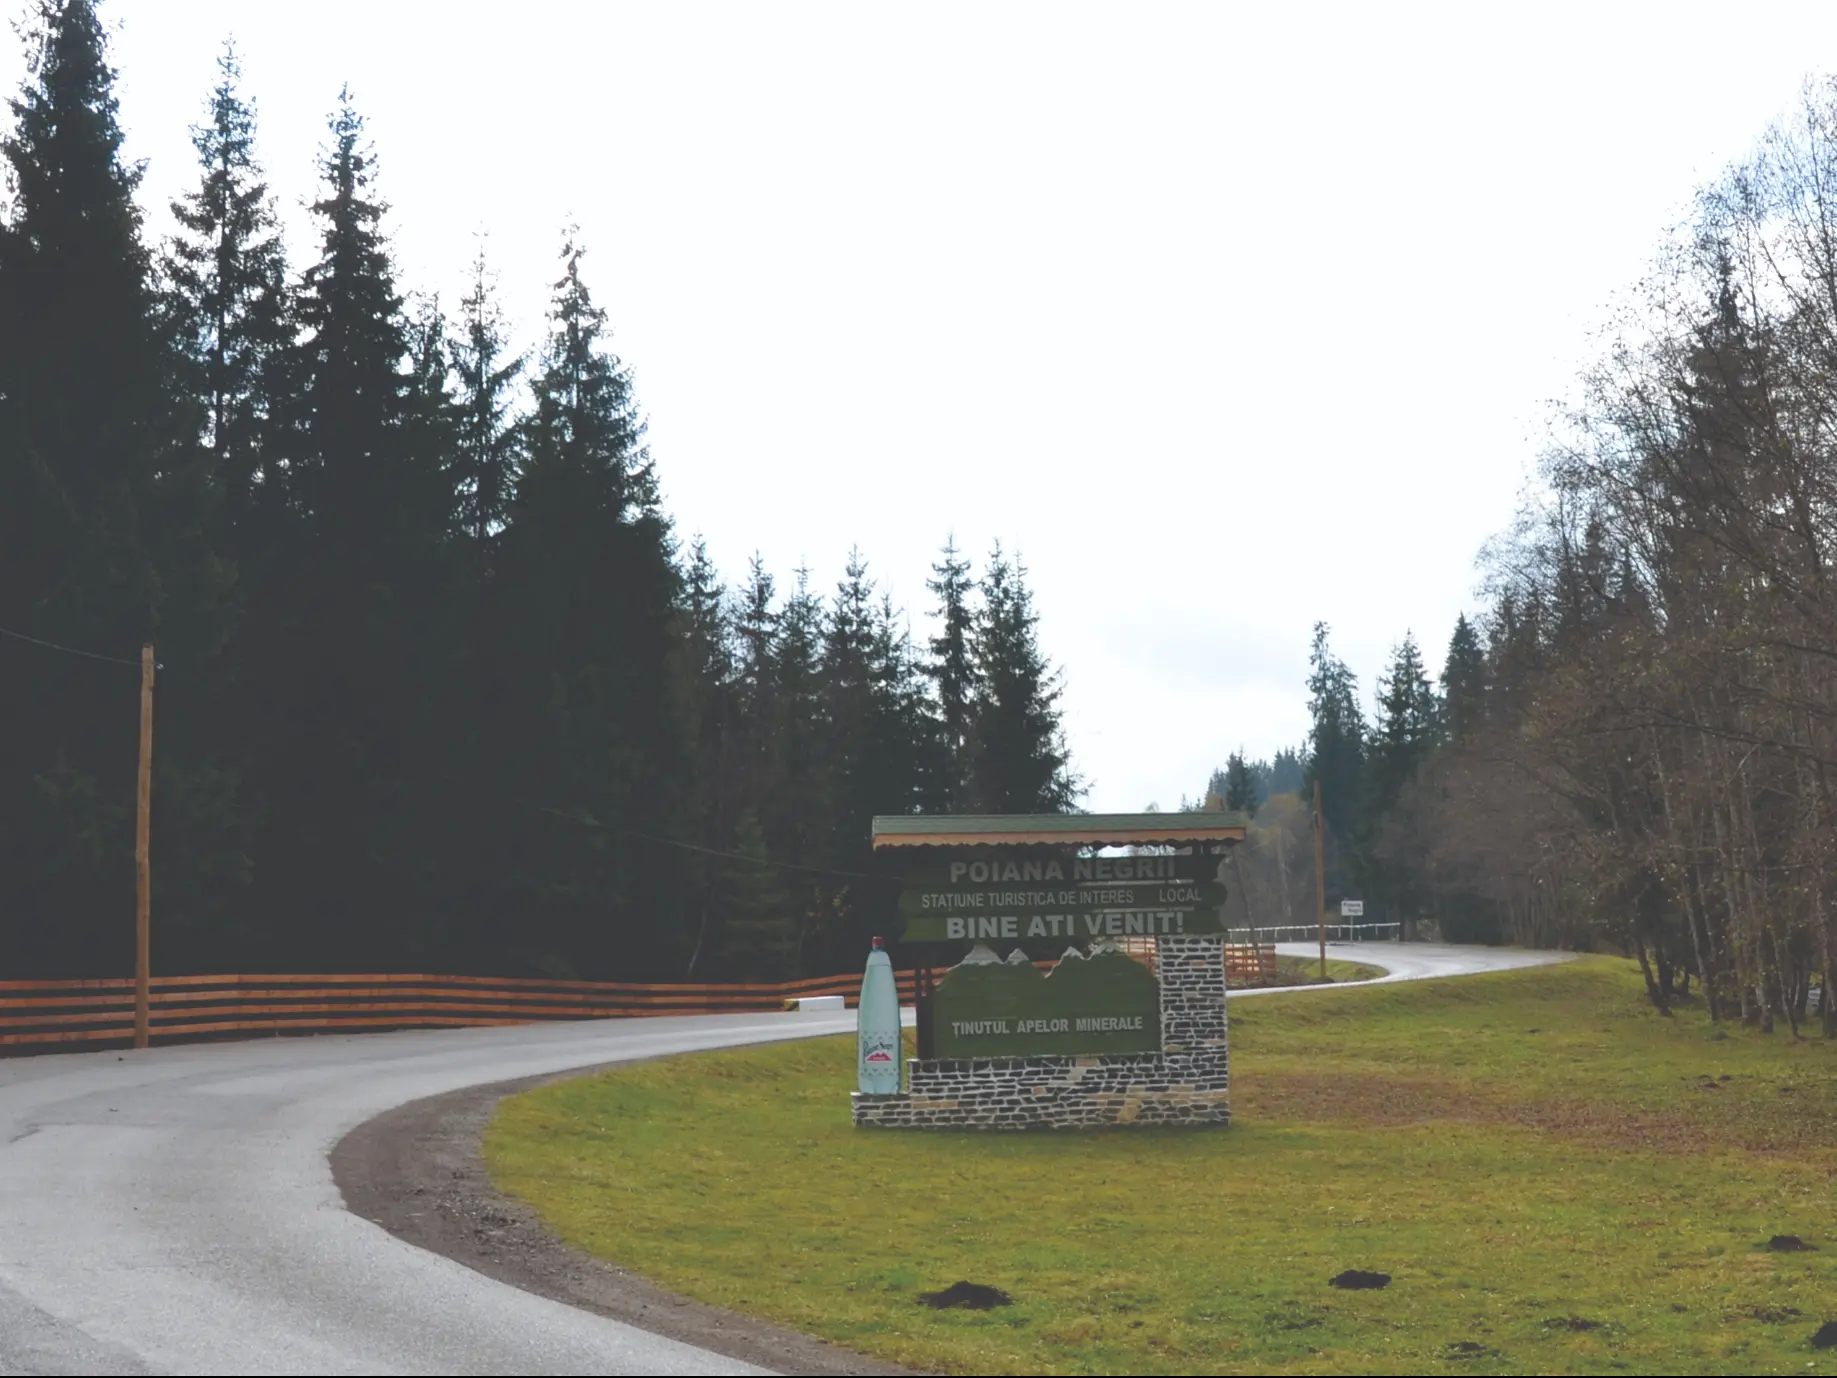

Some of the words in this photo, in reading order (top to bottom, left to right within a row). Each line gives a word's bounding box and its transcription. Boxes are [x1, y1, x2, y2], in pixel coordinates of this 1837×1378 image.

[951, 860, 1064, 883] POIANA
[1073, 857, 1175, 880] NEGRII
[988, 891, 1056, 906] TURISTICA
[1059, 891, 1077, 905] DE
[1080, 890, 1134, 904] INTERES
[1159, 887, 1202, 902] LOCAL
[947, 916, 1018, 939] BINE
[1027, 915, 1075, 937] ATI
[1084, 911, 1184, 936] VENIT!
[1017, 1018, 1069, 1034] APELOR
[1076, 1016, 1143, 1032] MINERALE
